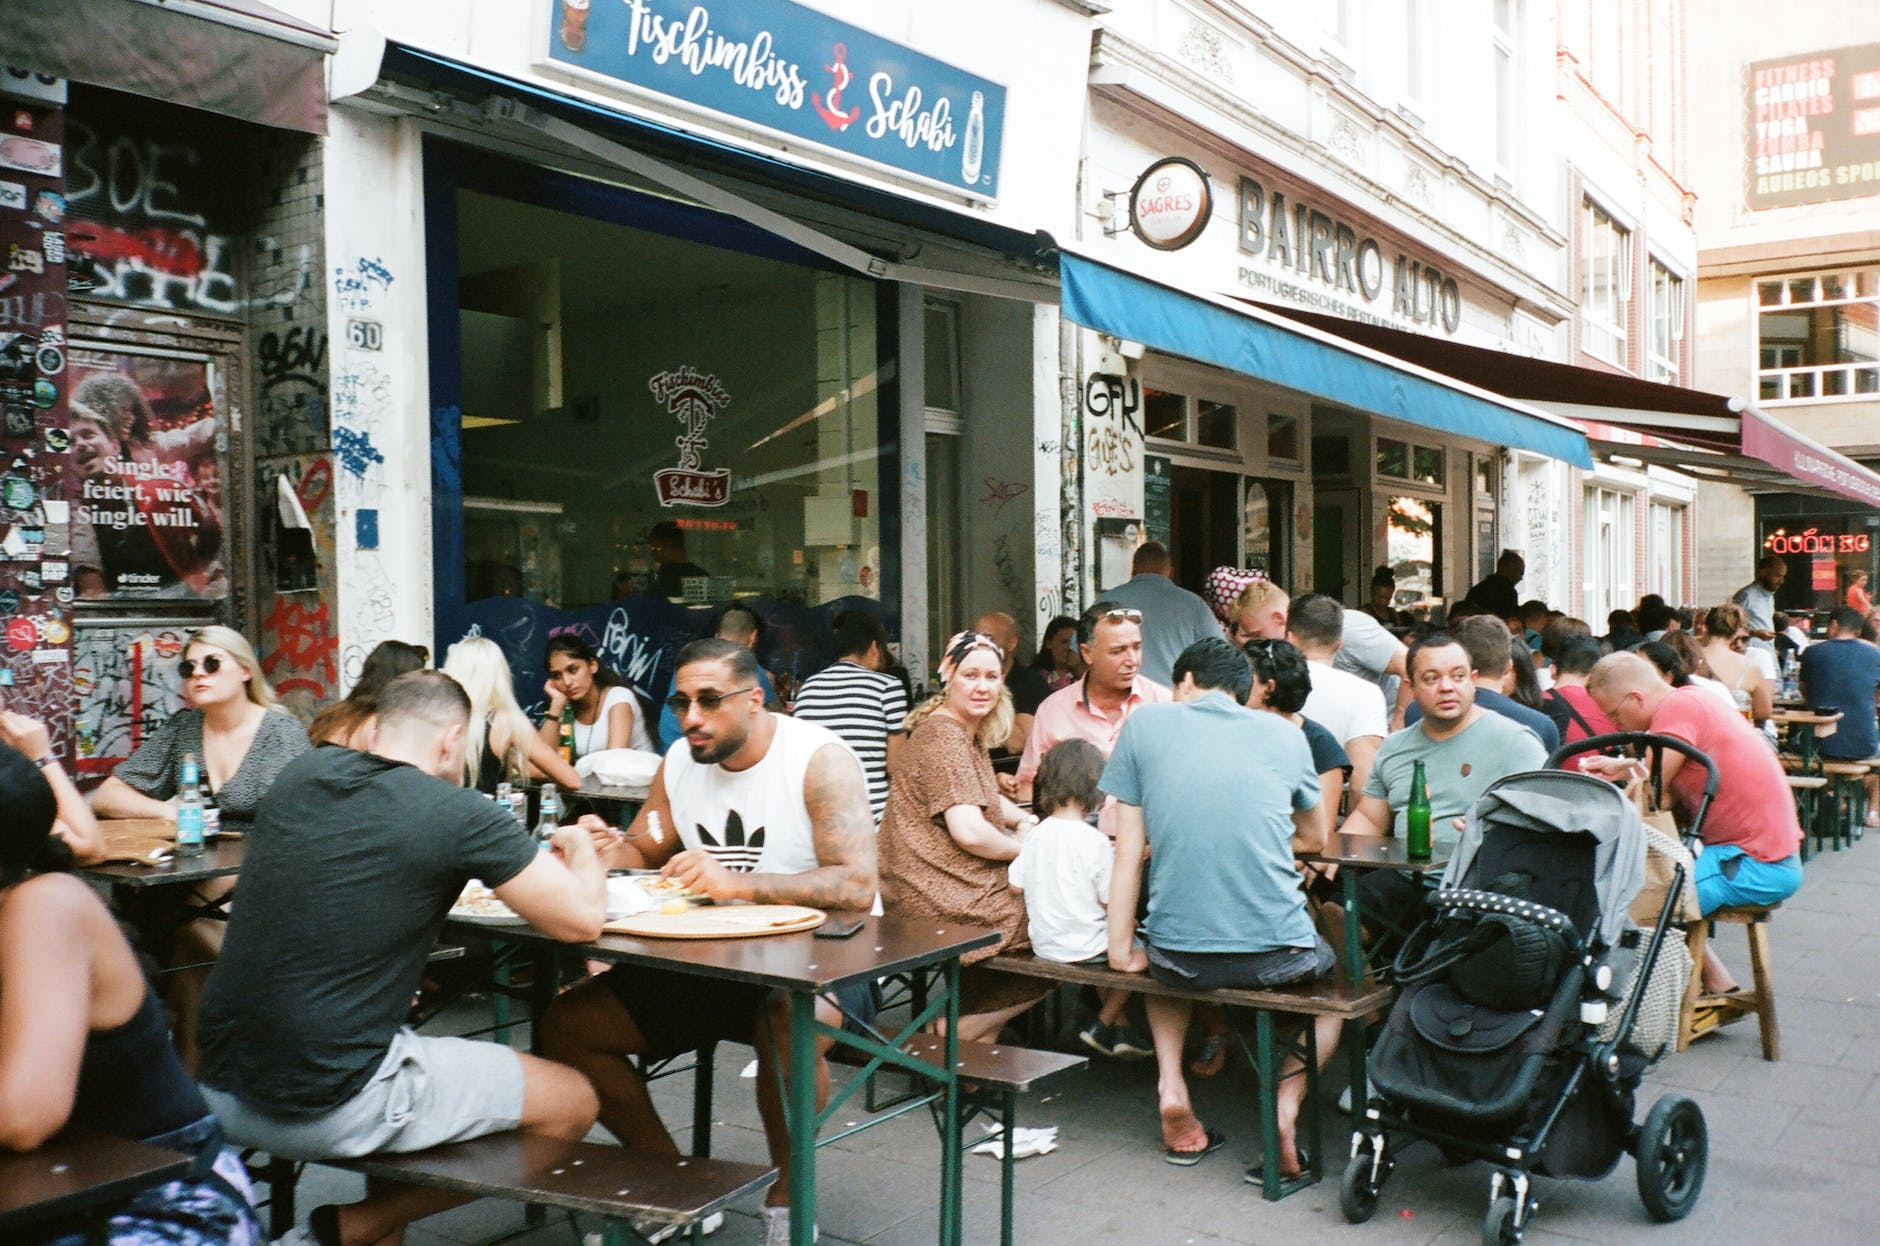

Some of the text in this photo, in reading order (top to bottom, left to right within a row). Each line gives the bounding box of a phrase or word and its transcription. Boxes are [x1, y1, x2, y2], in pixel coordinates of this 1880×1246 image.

[621, 0, 808, 110] Fischimbiss
[866, 72, 957, 152] Schabi
[1755, 59, 1835, 88] FITNESS
[1755, 77, 1831, 106] CARDIO
[1755, 95, 1834, 123] PILATES
[1756, 115, 1809, 140] YOGA
[1756, 130, 1825, 157] ZUMBA
[1756, 149, 1823, 175] SAUNA
[1756, 168, 1832, 194] AUREOS
[1139, 193, 1193, 218] SAGRES
[1238, 174, 1462, 334] BAIRRO ALTO
[1237, 266, 1346, 316] PORTUGIESISCHES
[348, 320, 382, 350] 60
[648, 365, 731, 408] Fischimbiss
[103, 455, 170, 481] Single
[83, 479, 193, 504] feiert, wie
[77, 505, 200, 530] Single will.
[128, 572, 161, 585] tinder
